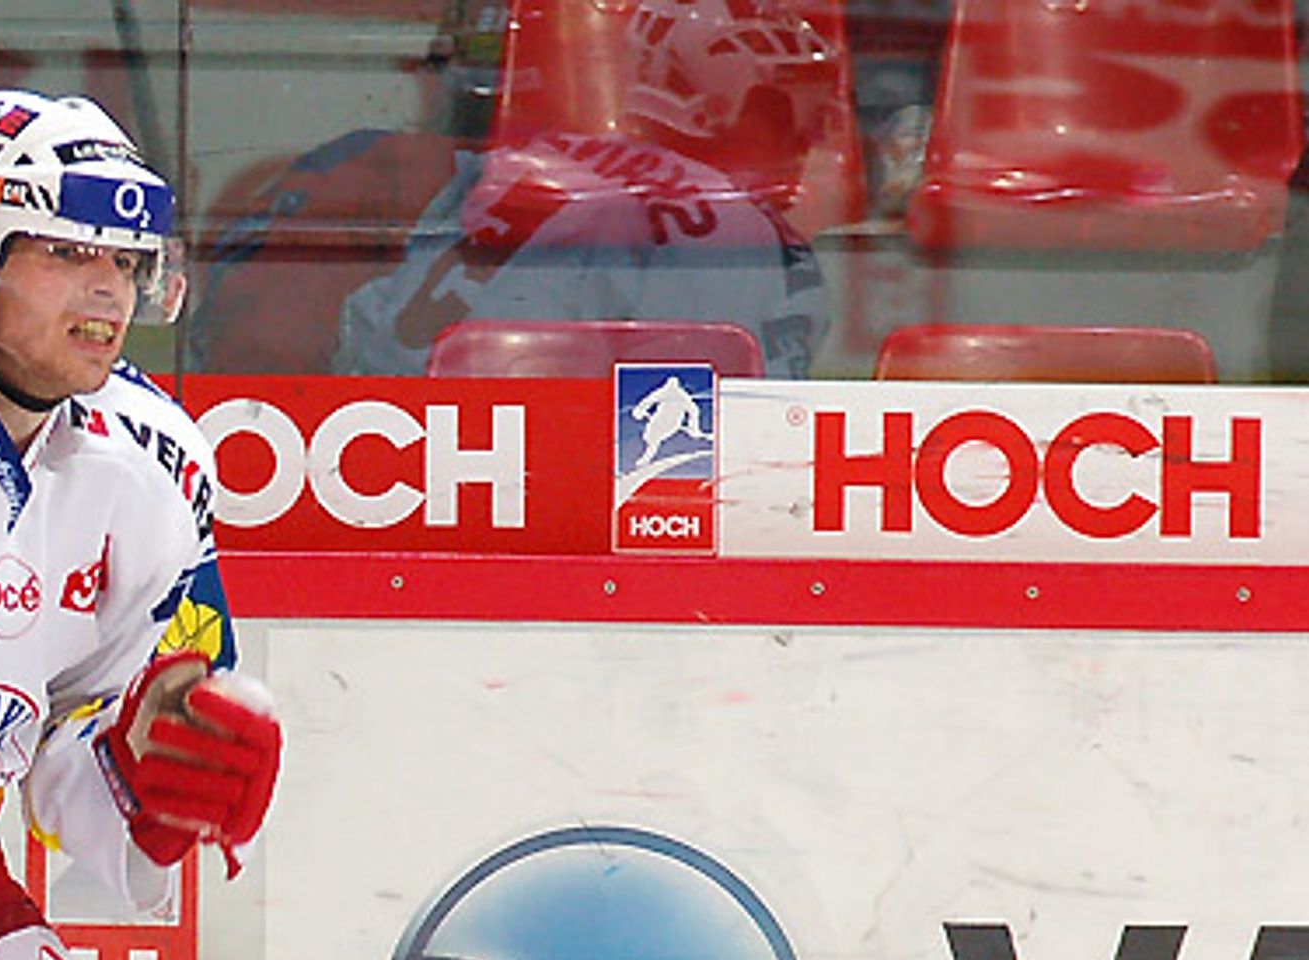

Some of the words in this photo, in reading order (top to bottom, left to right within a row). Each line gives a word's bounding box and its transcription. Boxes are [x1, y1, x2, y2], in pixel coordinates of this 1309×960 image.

[211, 399, 525, 529] OCH
[629, 515, 700, 537] HOCH
[812, 409, 1262, 540] HOCH
